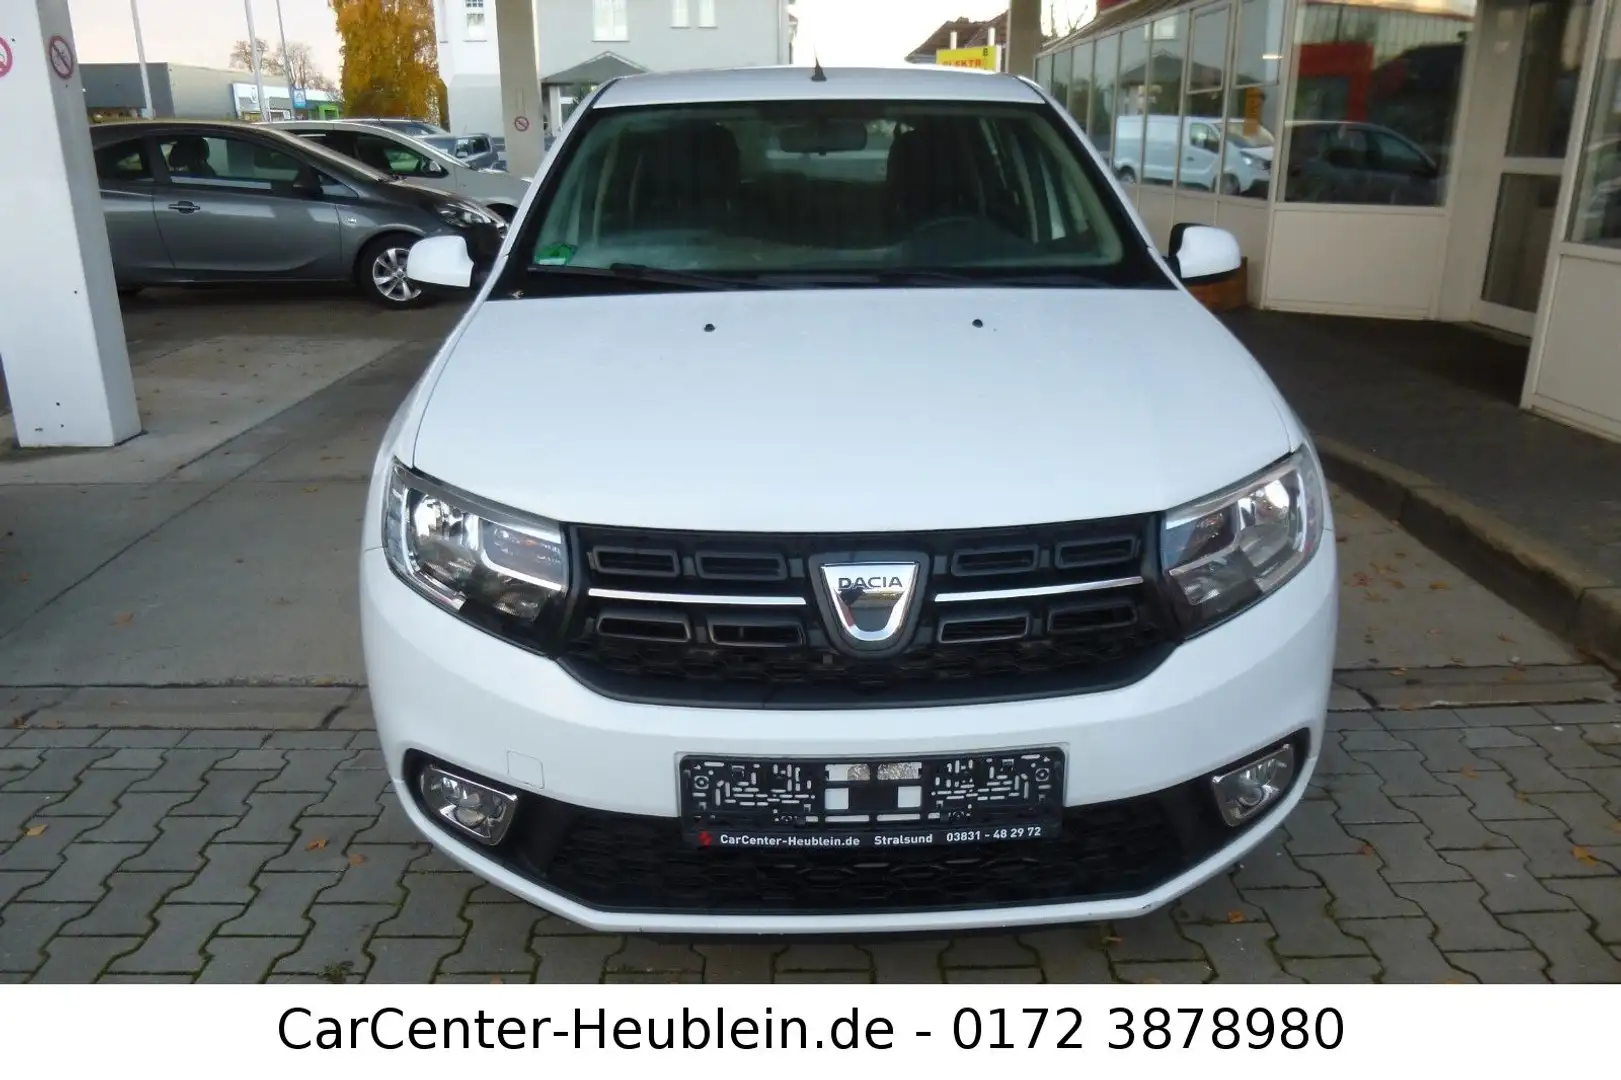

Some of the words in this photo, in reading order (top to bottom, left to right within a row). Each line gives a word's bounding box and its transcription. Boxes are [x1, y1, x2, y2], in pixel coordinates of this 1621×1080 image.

[838, 577, 903, 591] DACIA
[720, 834, 860, 846] CarCenter-Heublein.de
[874, 833, 933, 845] Stralsund
[946, 830, 981, 842] 03831
[993, 829, 1008, 839] 48
[1010, 827, 1025, 838] 29
[1027, 826, 1042, 837] 72
